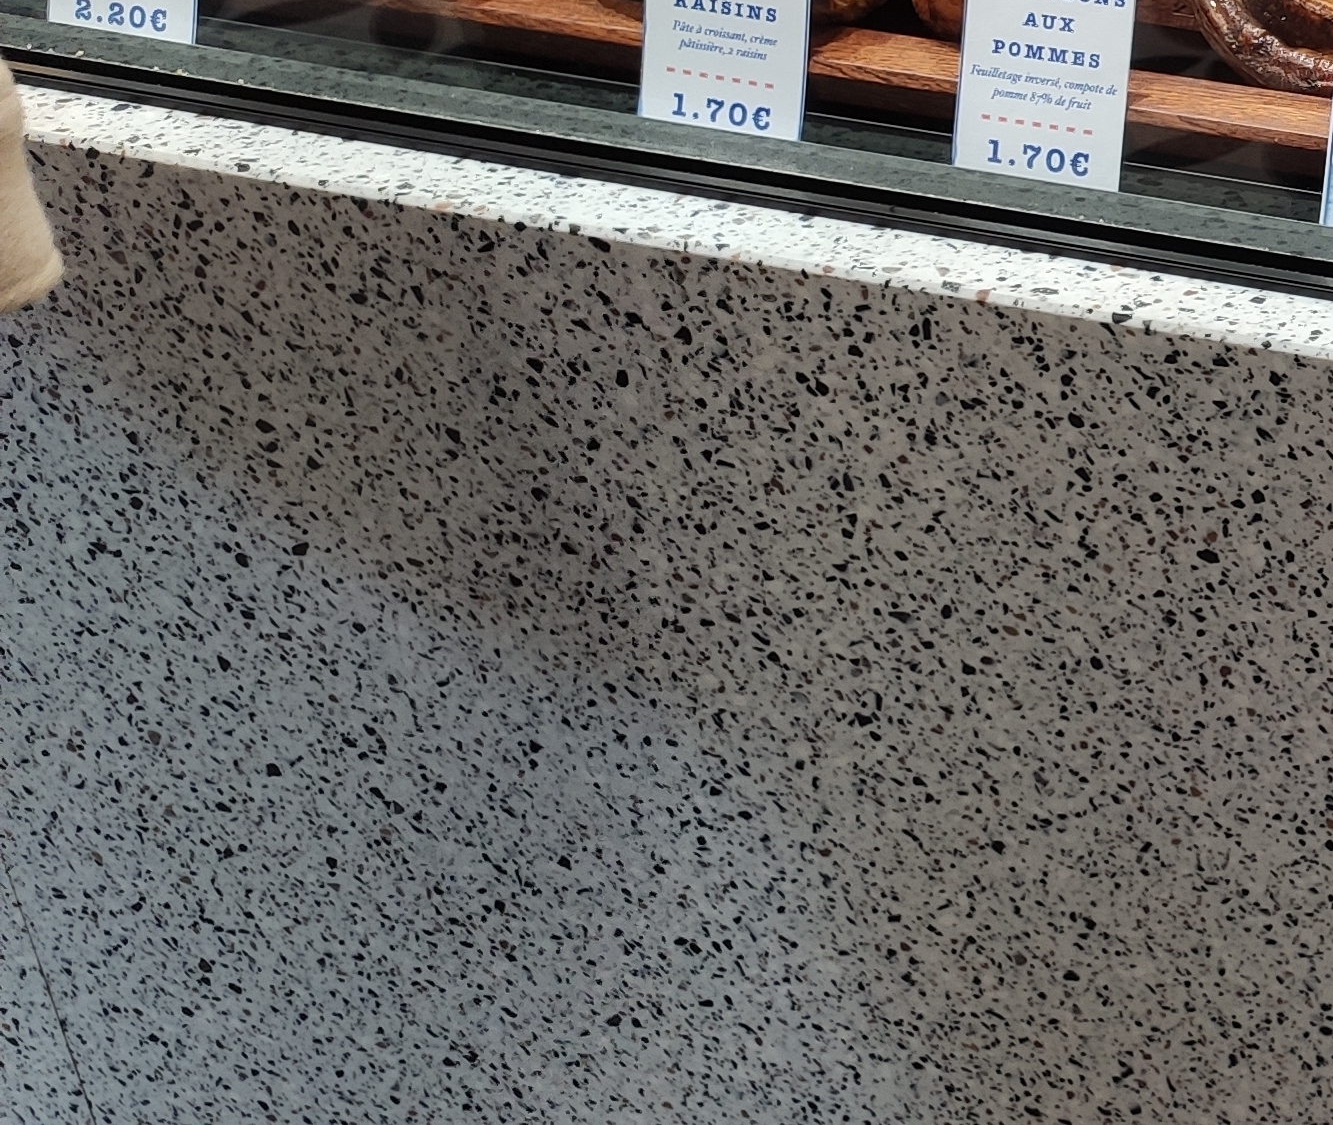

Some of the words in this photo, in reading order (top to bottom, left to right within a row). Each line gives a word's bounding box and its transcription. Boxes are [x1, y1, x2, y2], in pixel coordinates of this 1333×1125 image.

[672, 20, 694, 33] Pâte
[696, 24, 702, 34] à
[704, 28, 747, 43] croissant,
[750, 35, 777, 46] crème
[1022, 12, 1075, 33] AUX
[678, 38, 725, 55] pâtissière,
[736, 48, 767, 60] raisins
[992, 39, 1100, 69] POMMES
[970, 64, 1023, 84] Feuilletage
[1064, 81, 1104, 95] compote
[1106, 85, 1118, 96] de
[672, 92, 771, 130] 1.70€
[991, 88, 1028, 101] pomme
[1055, 96, 1066, 106] de
[1065, 97, 1092, 111] fruit
[987, 139, 1090, 177] 1.70€
